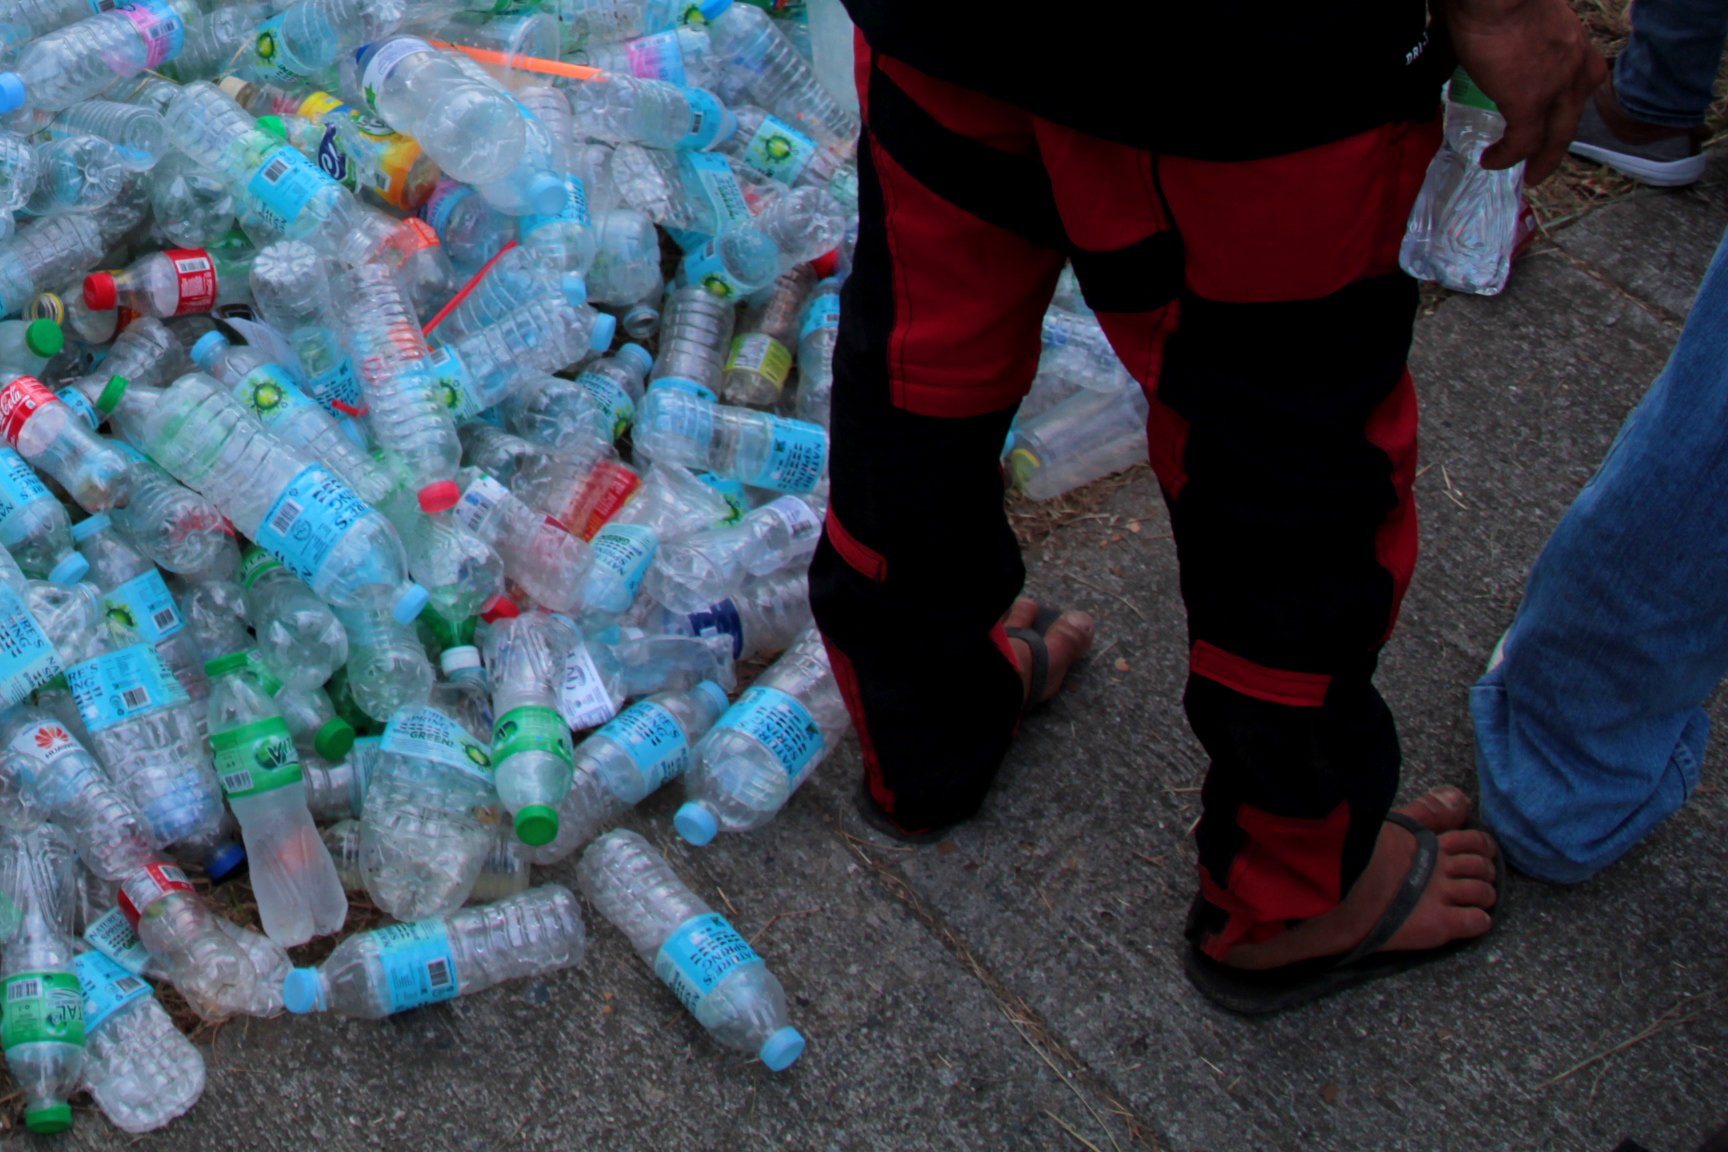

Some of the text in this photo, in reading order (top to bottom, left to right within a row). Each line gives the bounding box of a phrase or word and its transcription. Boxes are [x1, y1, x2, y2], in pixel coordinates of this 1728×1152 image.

[1405, 32, 1430, 67] DRI-
[68, 663, 99, 682] RE'S
[409, 730, 455, 748] GREEN!
[266, 737, 293, 767] VIT
[701, 943, 748, 970] SPRING
[55, 1005, 84, 1026] TAL
